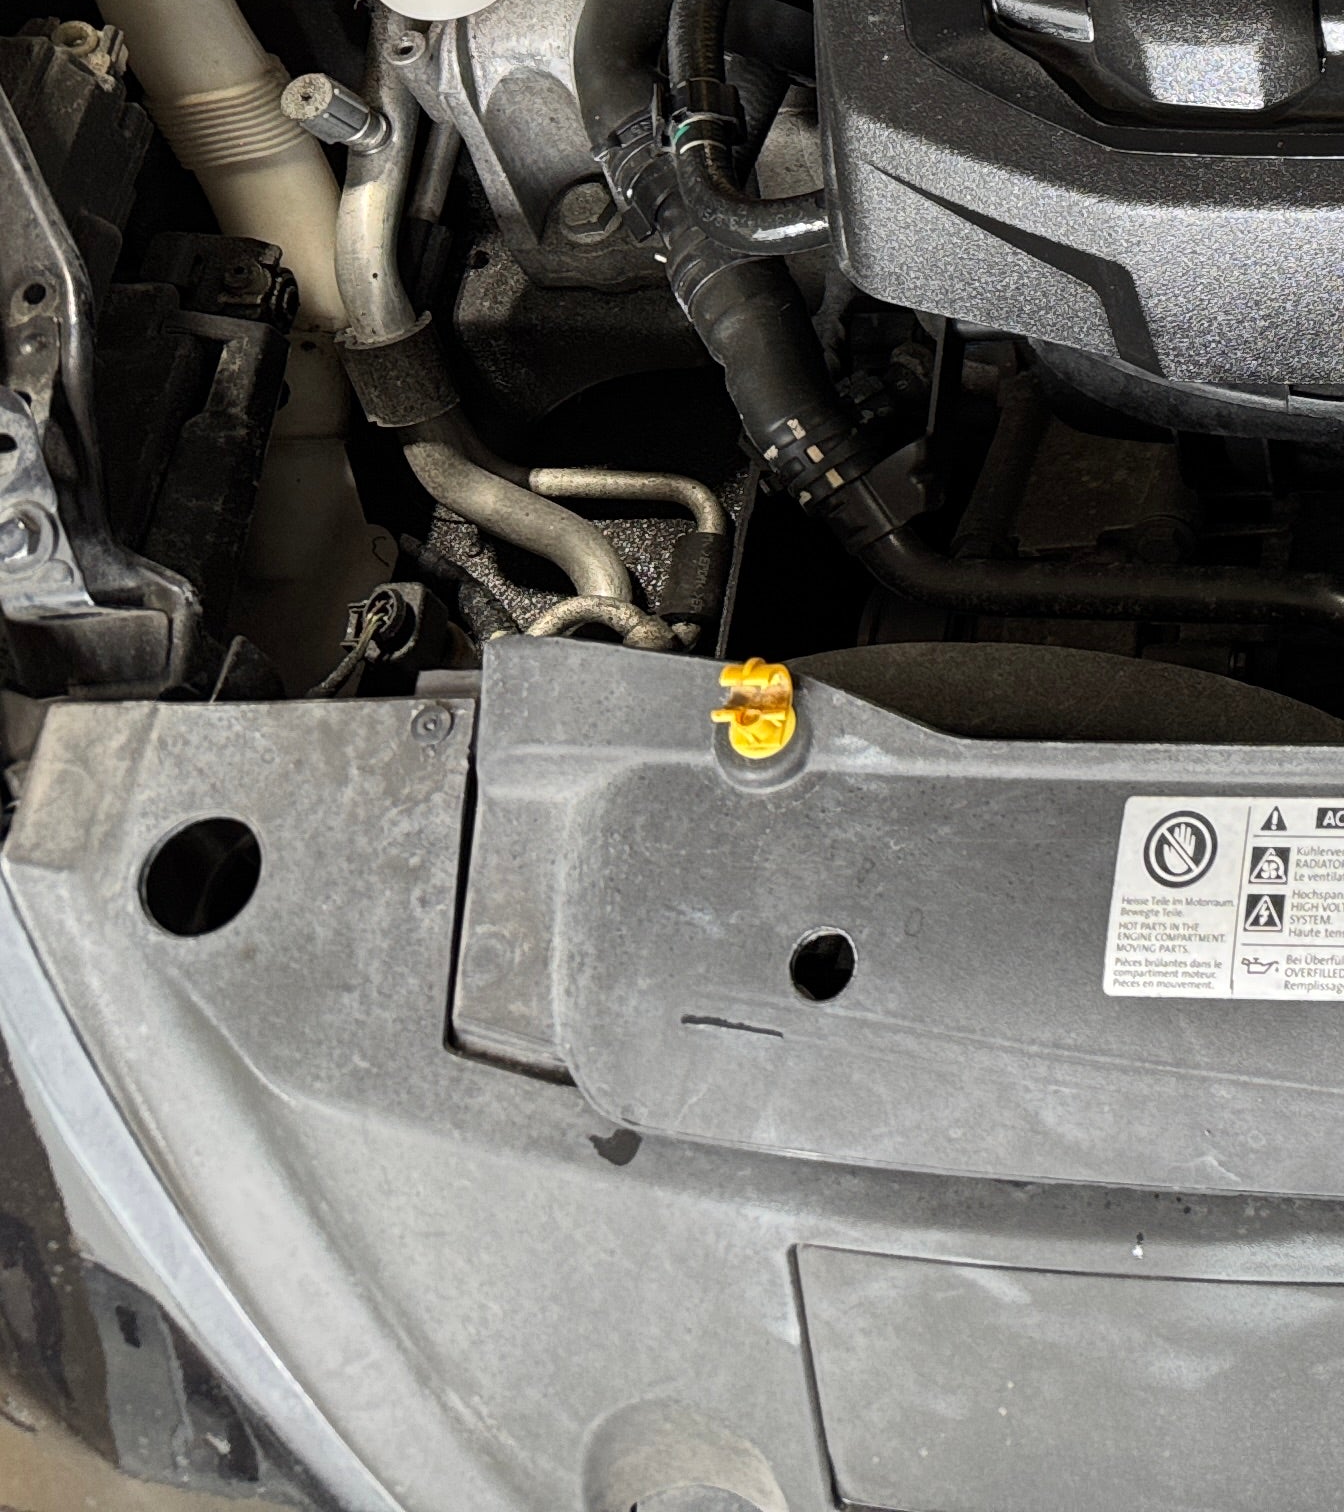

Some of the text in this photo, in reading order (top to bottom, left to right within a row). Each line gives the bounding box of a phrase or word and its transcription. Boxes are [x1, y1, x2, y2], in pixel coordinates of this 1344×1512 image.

[1294, 872, 1305, 882] Le
[1152, 896, 1170, 906] Teile
[1291, 902, 1319, 912] HIGH
[1119, 921, 1200, 932] HOT PARTS IN THE
[1118, 932, 1152, 942] ENGINE
[1289, 927, 1321, 938] Haute
[1116, 944, 1156, 953] MOVING
[1190, 959, 1222, 969] dans le
[1286, 954, 1302, 965] Bei
[1113, 969, 1179, 979] compartiment
[1142, 980, 1154, 988] en
